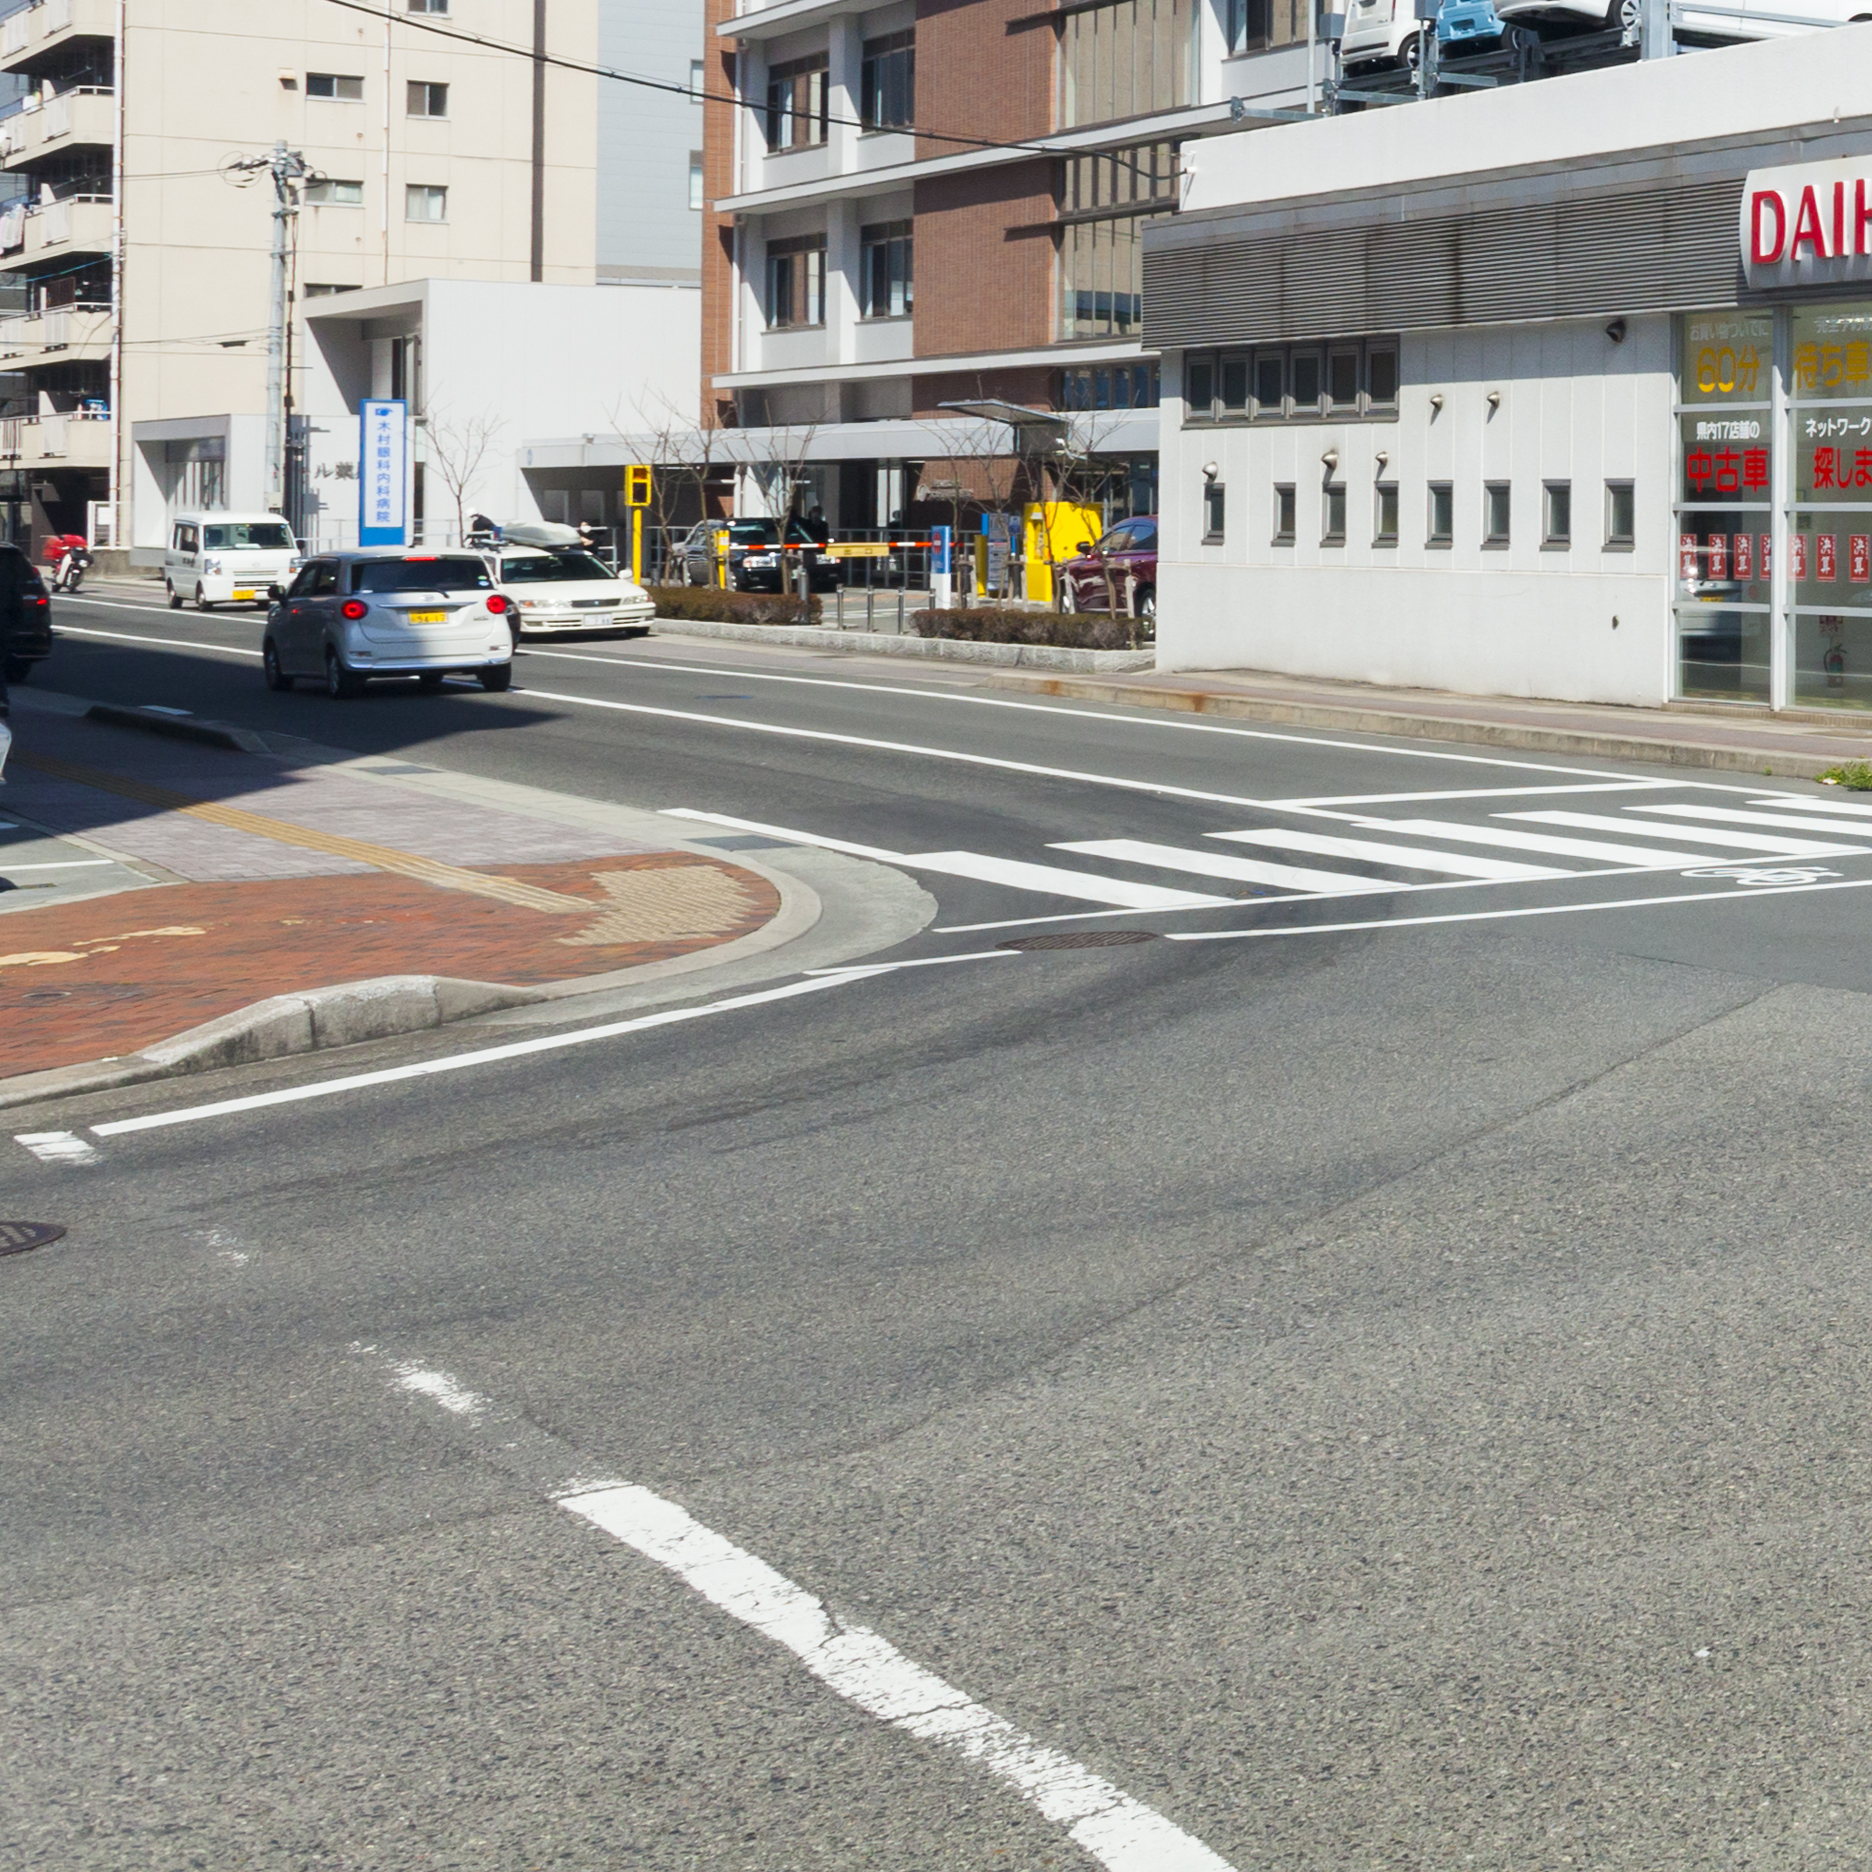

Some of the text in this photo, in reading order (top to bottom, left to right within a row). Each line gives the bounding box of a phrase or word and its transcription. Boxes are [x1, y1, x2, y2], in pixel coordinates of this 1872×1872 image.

[1697, 344, 1760, 393] 60分
[376, 421, 391, 522] 木村眼科内科病院
[1687, 446, 1768, 493] 中古車
